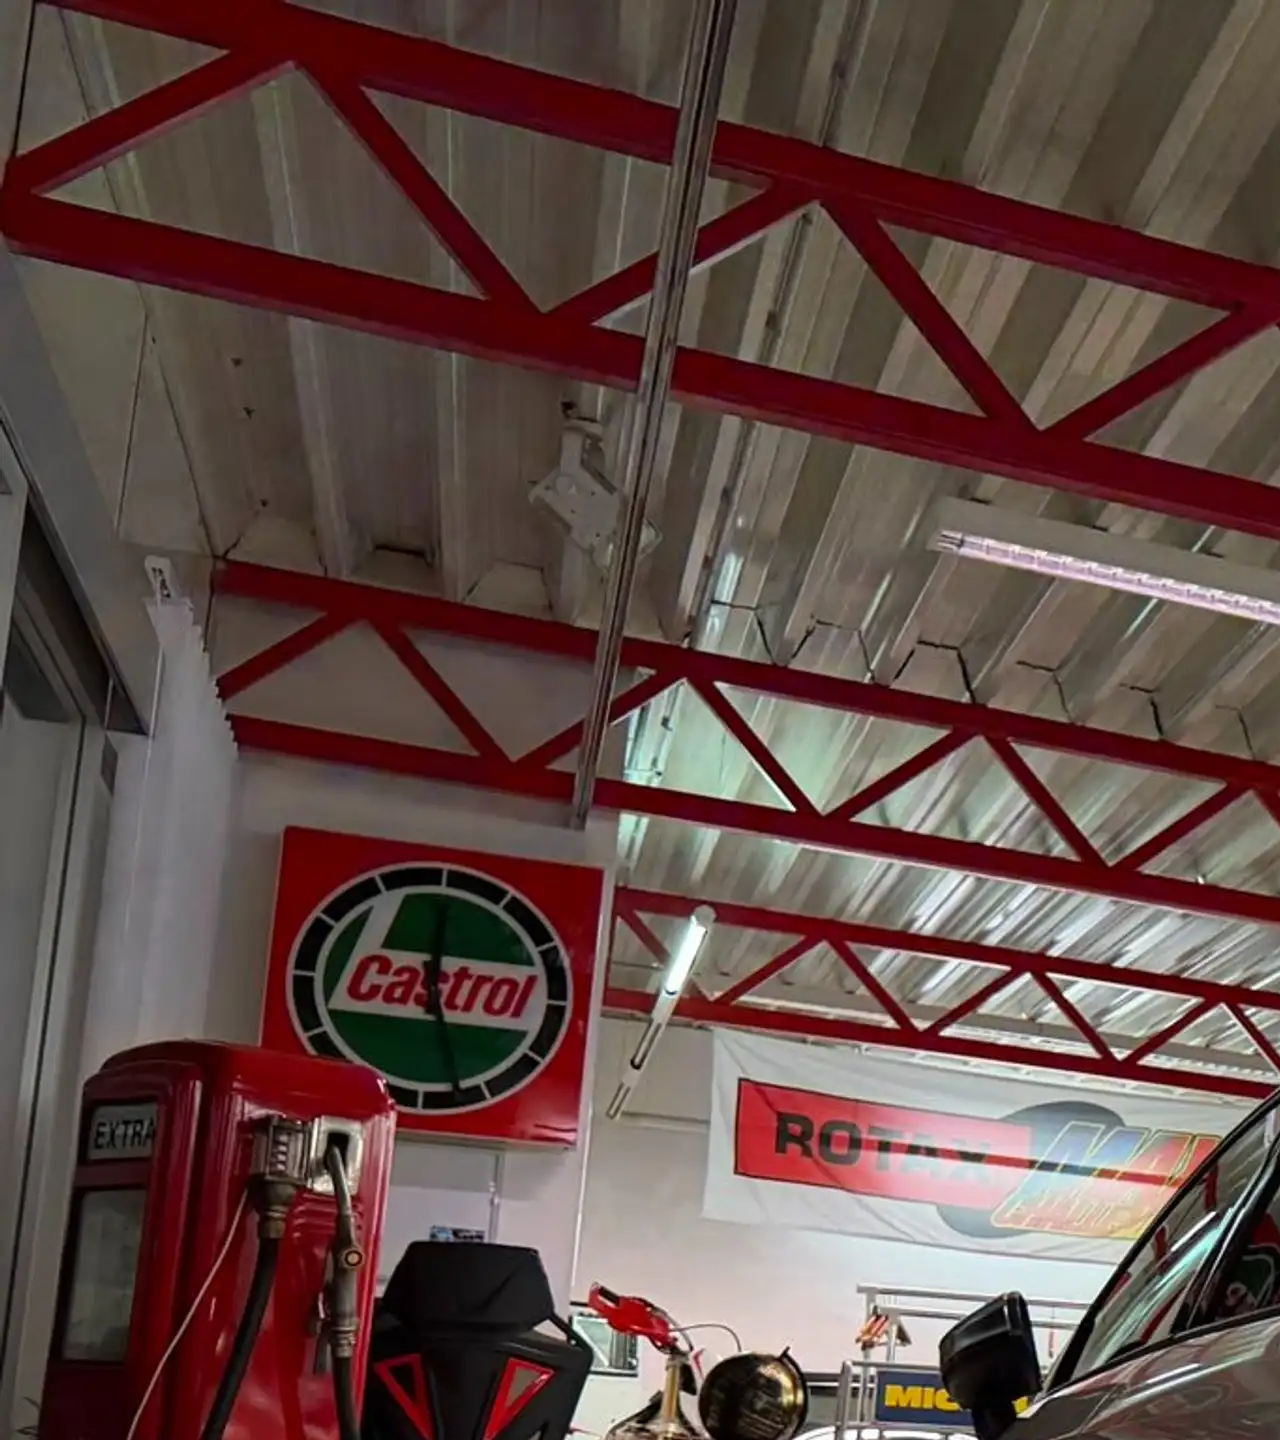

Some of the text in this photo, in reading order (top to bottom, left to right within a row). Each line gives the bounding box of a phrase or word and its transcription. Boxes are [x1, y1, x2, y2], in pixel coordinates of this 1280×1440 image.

[346, 953, 539, 1019] Castrol
[93, 1119, 156, 1150] EXTRA
[774, 1110, 992, 1183] ROTAX
